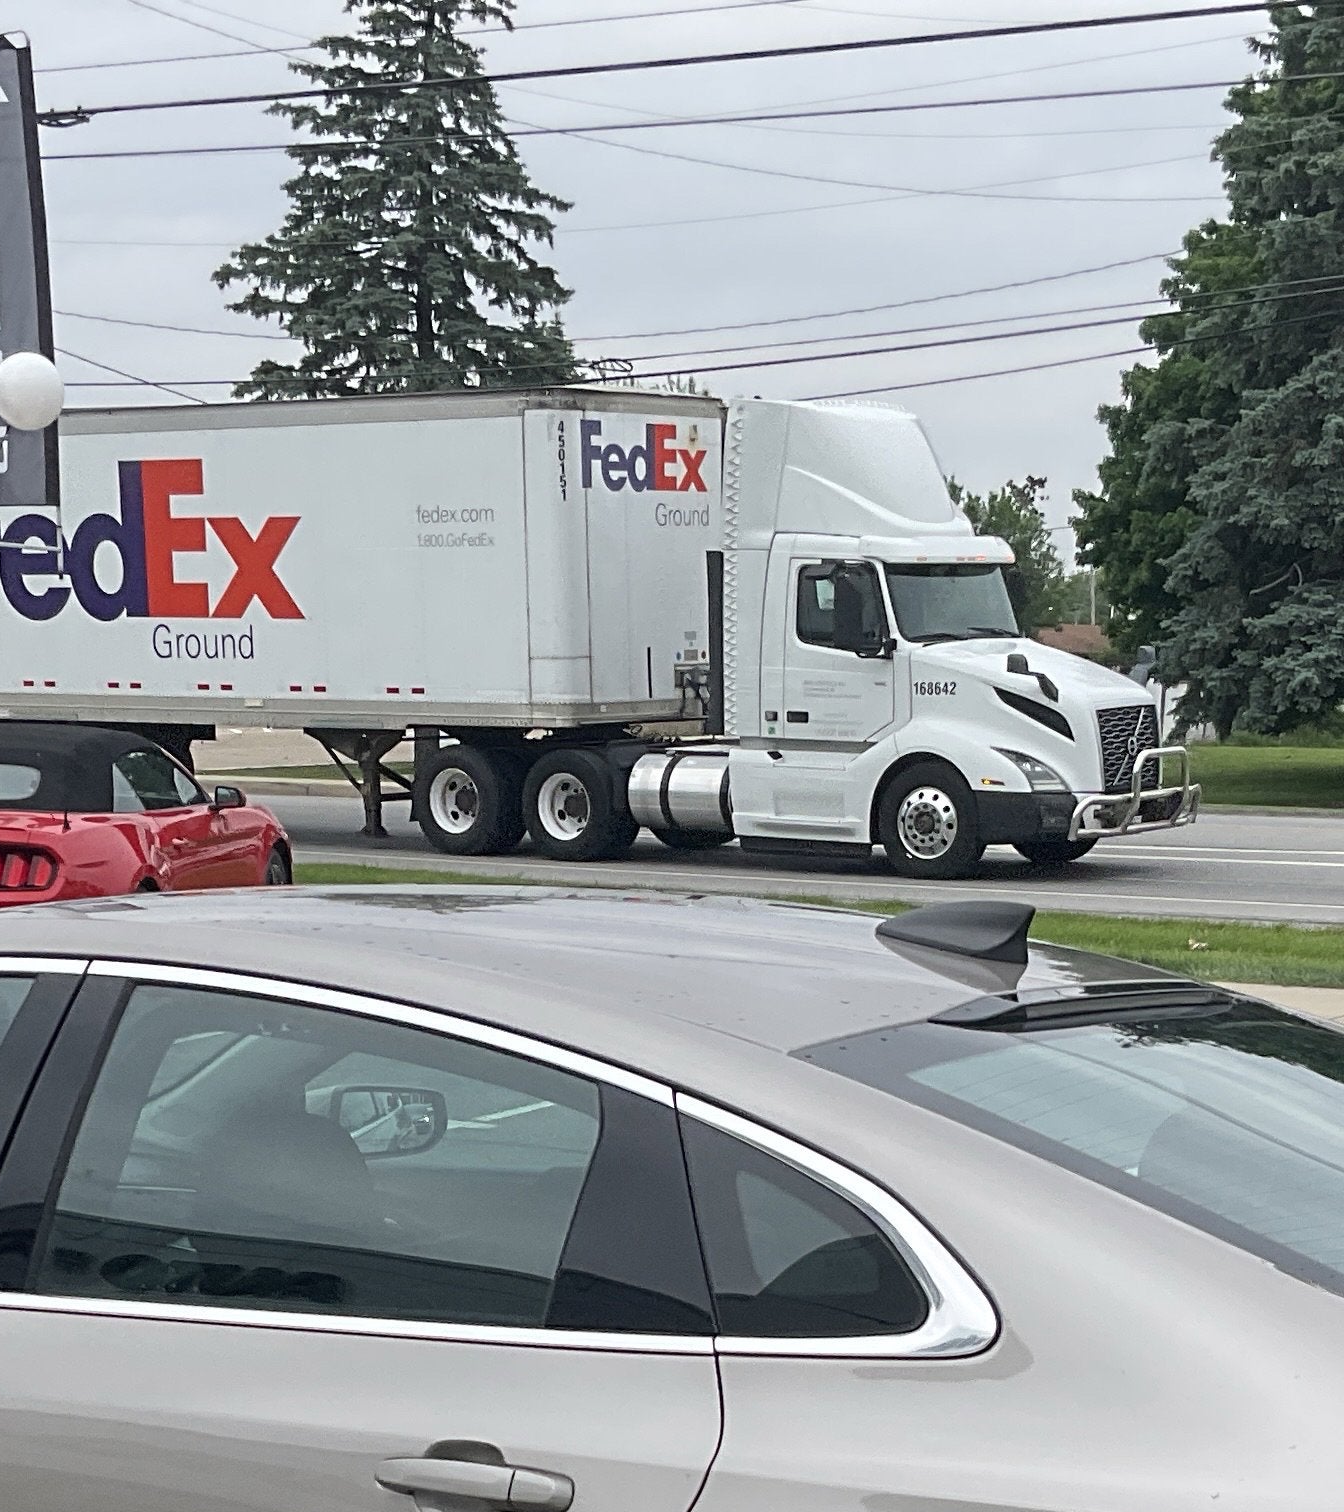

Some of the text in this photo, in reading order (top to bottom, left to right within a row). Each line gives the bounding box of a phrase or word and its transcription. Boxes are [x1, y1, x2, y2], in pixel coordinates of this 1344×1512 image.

[557, 420, 567, 501] 450151
[580, 419, 708, 493] FedEx
[416, 504, 495, 524] fedex.com
[655, 502, 710, 527] Ground
[152, 623, 255, 660] Ground
[913, 681, 957, 696] 168642
